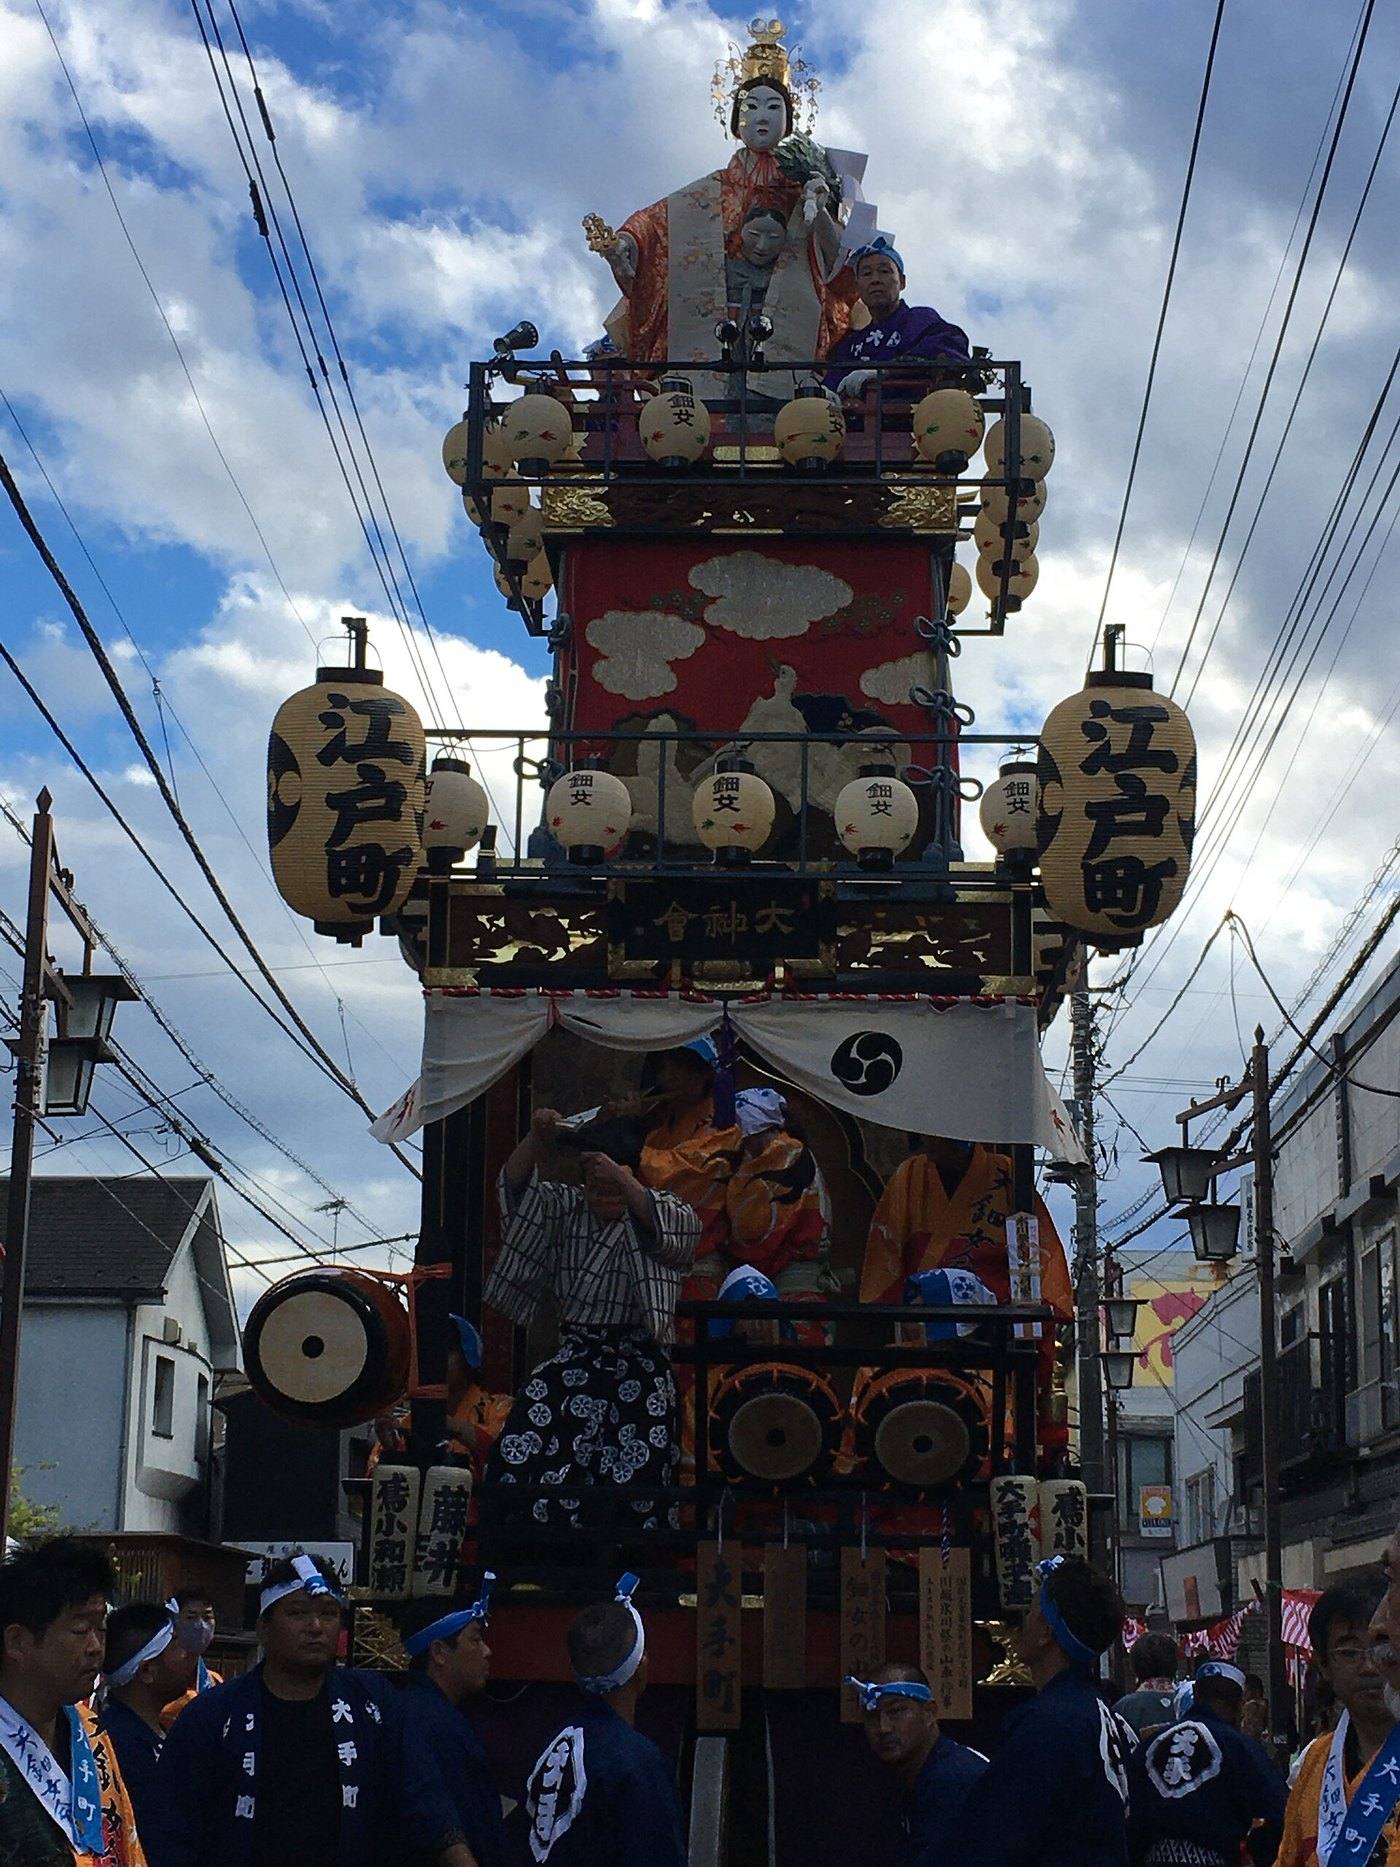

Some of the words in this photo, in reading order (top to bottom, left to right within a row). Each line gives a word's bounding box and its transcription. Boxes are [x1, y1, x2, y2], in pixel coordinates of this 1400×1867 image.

[668, 394, 695, 427] 鈿女
[315, 693, 413, 914] 江戸町
[567, 773, 593, 806] 鈿女
[713, 776, 742, 812] 鈿女
[866, 783, 893, 816] 鈿女
[1003, 781, 1030, 815] 鈿女
[1079, 699, 1179, 928] 江戸町
[331, 1698, 360, 1808] 大手町
[1345, 1756, 1400, 1853] 大手町
